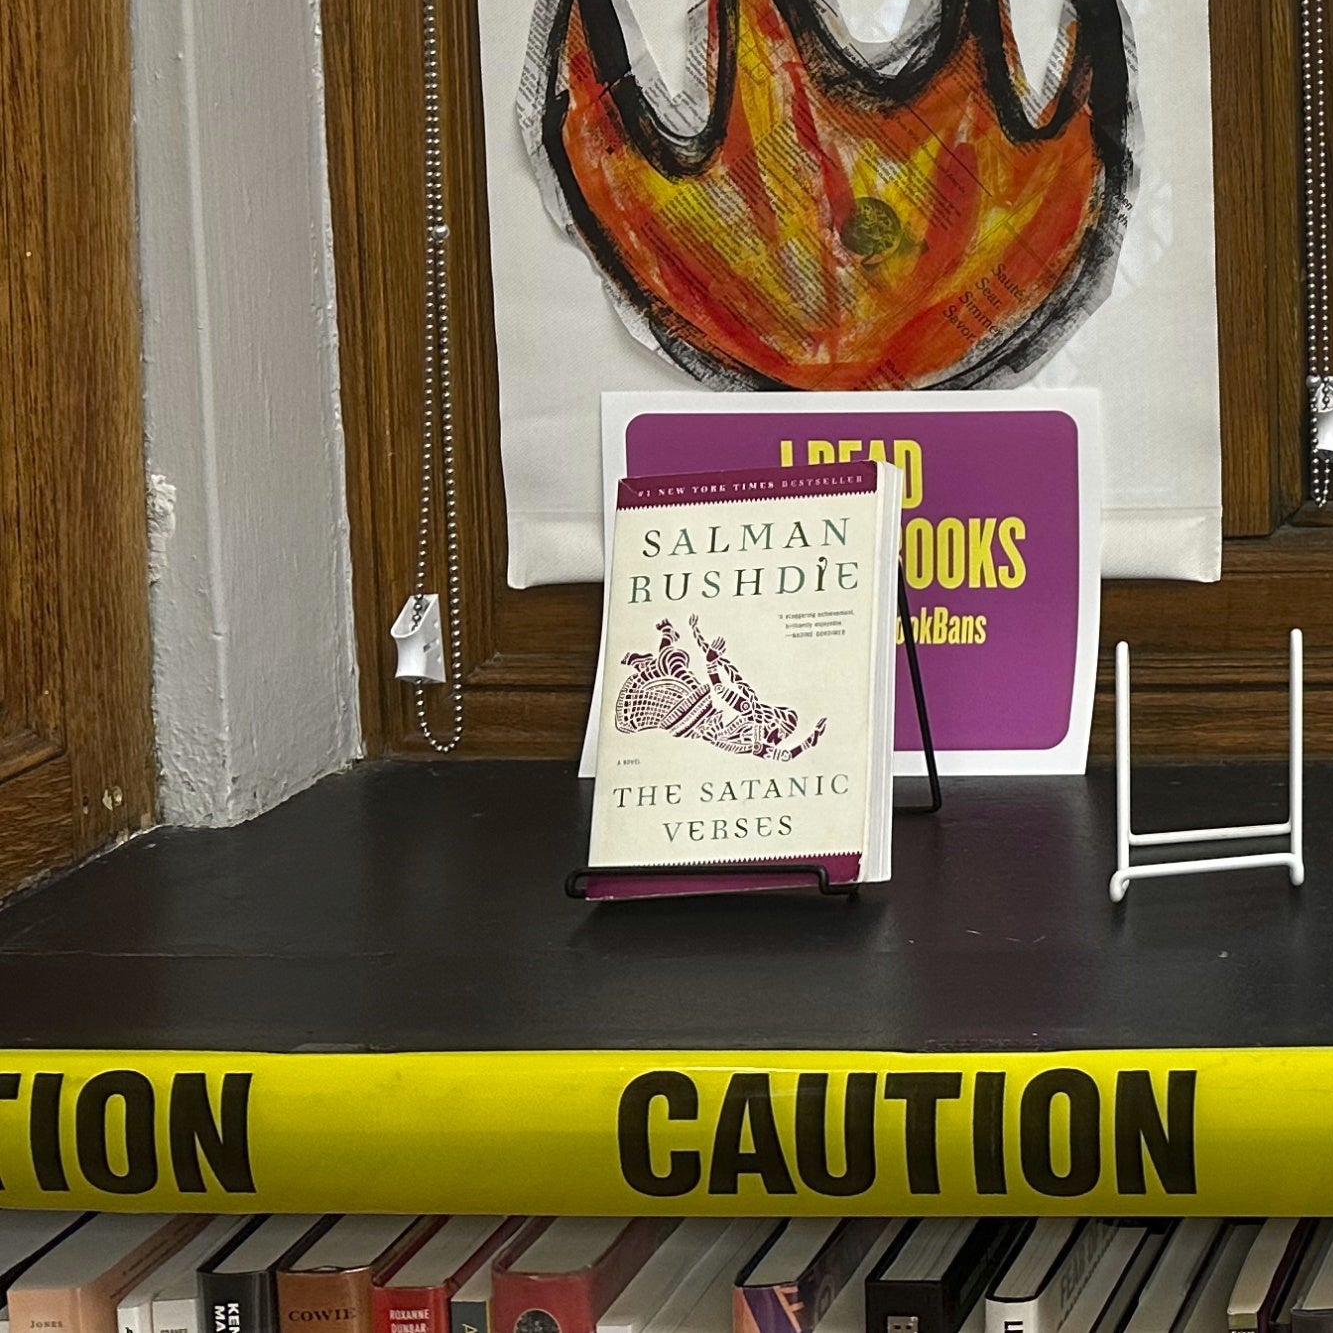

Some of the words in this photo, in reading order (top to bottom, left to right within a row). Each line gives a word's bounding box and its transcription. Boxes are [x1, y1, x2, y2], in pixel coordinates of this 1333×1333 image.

[657, 486, 685, 497] NEW
[692, 483, 727, 495] YORK
[732, 480, 776, 493] TIMES
[781, 475, 864, 489] BESTSELLER
[641, 517, 851, 558] SALMAN
[897, 515, 1027, 590] OOKS
[627, 556, 859, 604] RUSHDIE
[613, 784, 682, 808] THE
[699, 773, 850, 803] SATANIC
[661, 815, 793, 842] VERSES
[617, 1068, 1198, 1198] CAUTION
[288, 1307, 356, 1322] COWIE
[389, 1308, 430, 1320] ROXANNE
